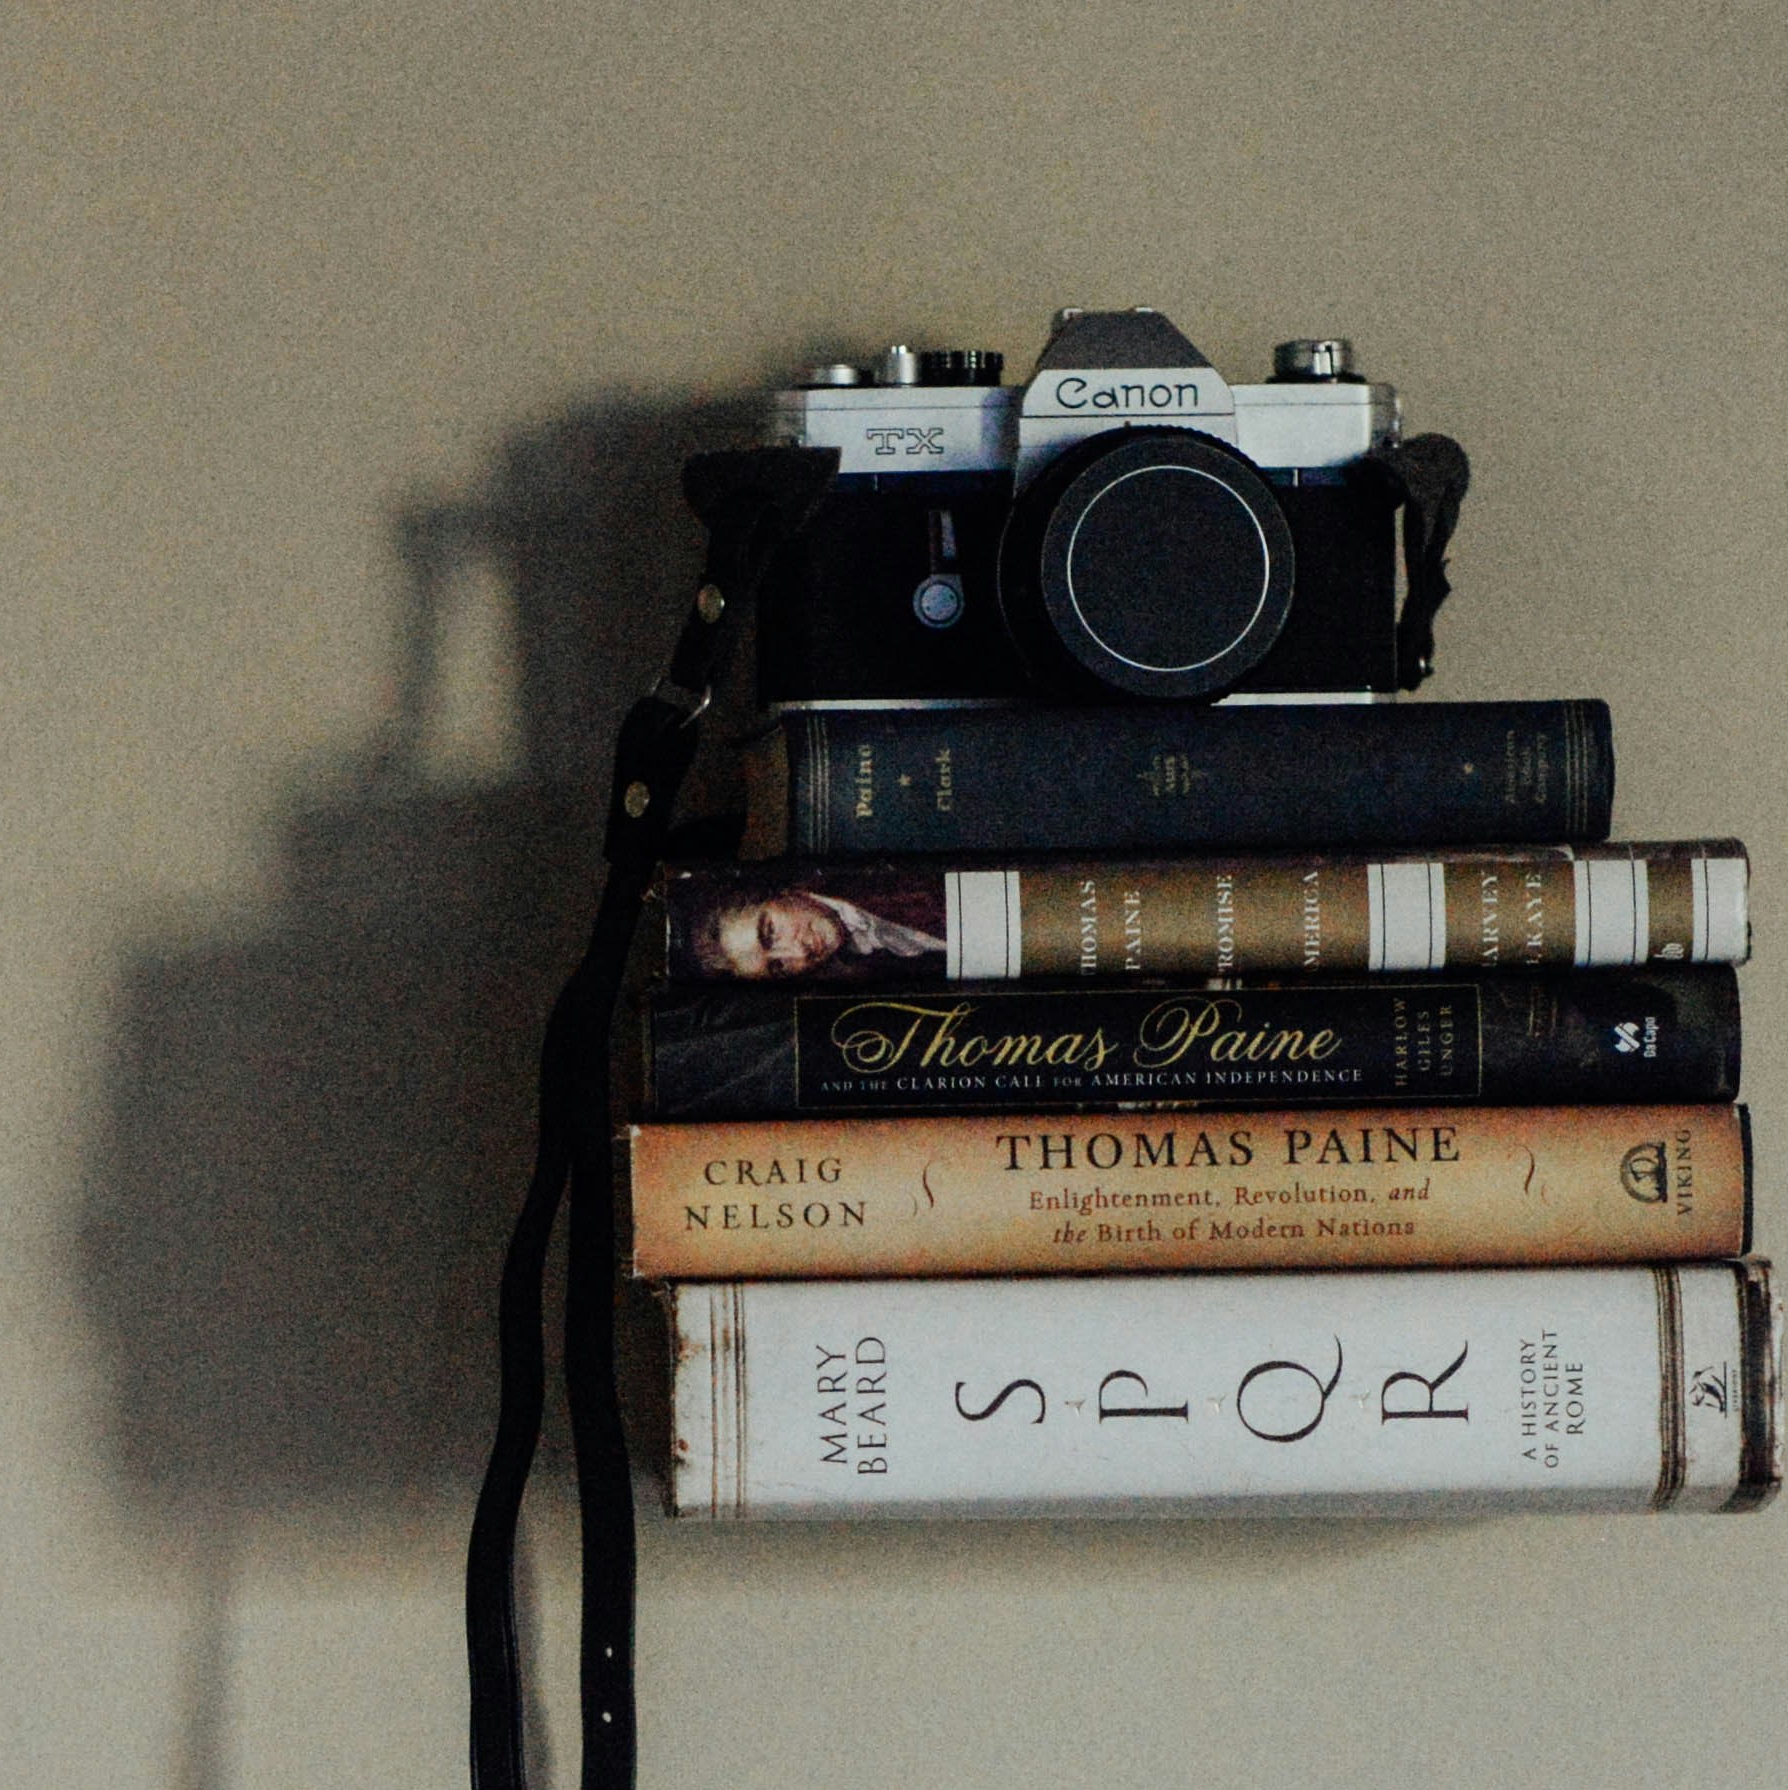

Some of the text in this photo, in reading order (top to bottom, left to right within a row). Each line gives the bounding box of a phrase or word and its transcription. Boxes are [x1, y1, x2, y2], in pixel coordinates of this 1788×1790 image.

[1055, 376, 1199, 411] Canon
[866, 427, 945, 456] TX
[936, 747, 953, 813] Clark
[1124, 889, 1142, 971] PAINE
[1526, 872, 1543, 945] KAYE
[830, 996, 1343, 1074] Thomas Paine
[1394, 995, 1409, 1087] HARLOW
[1417, 1010, 1431, 1072] GILES
[1440, 1004, 1454, 1077] UNGER
[1644, 1016, 1659, 1058] Da Capo
[821, 1067, 1364, 1092] AND THE CLARION CALL FOR AMERICAN INDEPENDENCE
[704, 1157, 843, 1186] CRAIG
[995, 1126, 1461, 1171] THOMAS PAINE
[1676, 1128, 1693, 1217] VIKING
[684, 1200, 867, 1231] NELSON
[1028, 1178, 1431, 1215] Enlightenment, Revolution, and
[1052, 1216, 1416, 1244] the Birth of Modern Nations
[815, 1343, 848, 1465] MARY
[855, 1335, 888, 1475] BEARD
[1519, 1338, 1537, 1462] A HISTORY
[1542, 1329, 1561, 1469] OF ANCIENT
[1565, 1360, 1585, 1437] ROME
